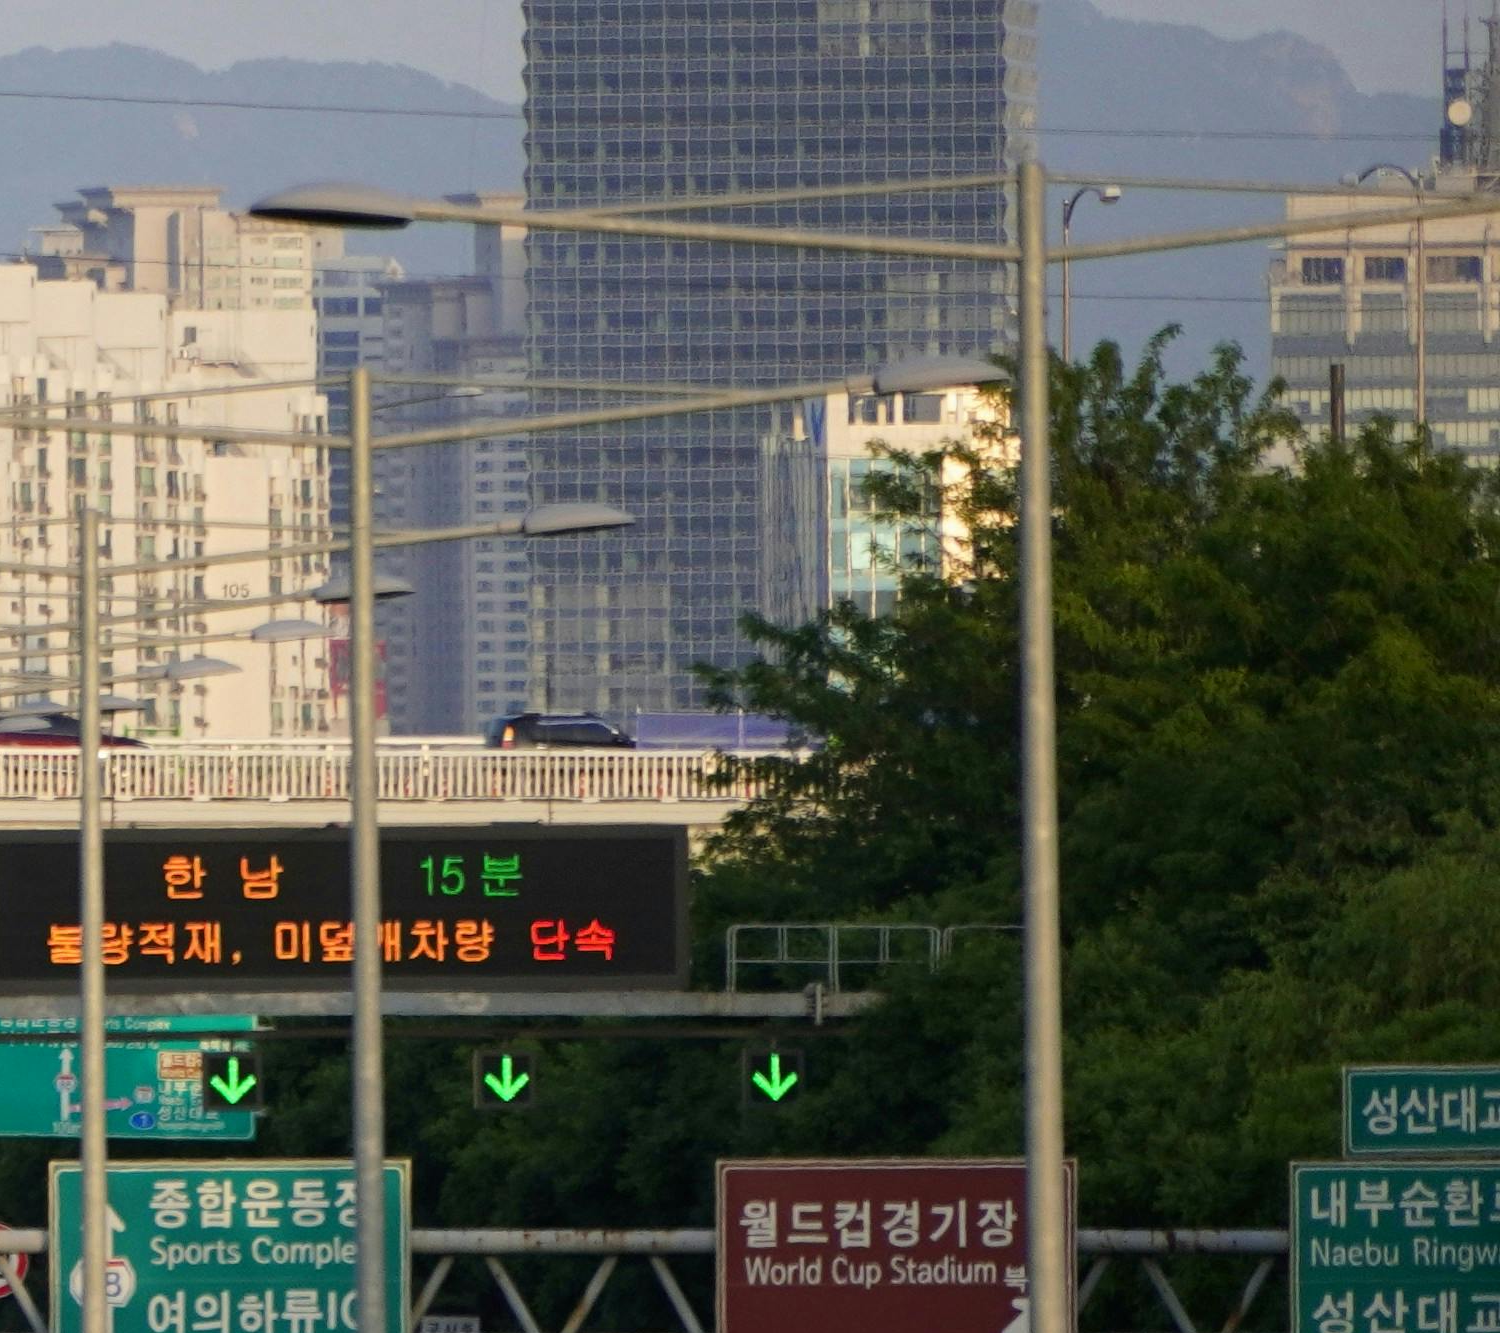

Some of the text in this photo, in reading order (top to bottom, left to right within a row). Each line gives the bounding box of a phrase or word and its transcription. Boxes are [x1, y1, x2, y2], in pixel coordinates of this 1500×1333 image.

[222, 583, 250, 598] 105
[162, 854, 206, 899] 한
[241, 854, 285, 899] 남
[529, 918, 617, 962] 단속
[1311, 1178, 1500, 1228] 내부순환
[740, 1199, 1018, 1249] 월드컵경기장
[150, 1235, 358, 1270] Sports Comple
[744, 1254, 997, 1289] World Cup Stadium
[1311, 1237, 1500, 1272] Naebu Ringw
